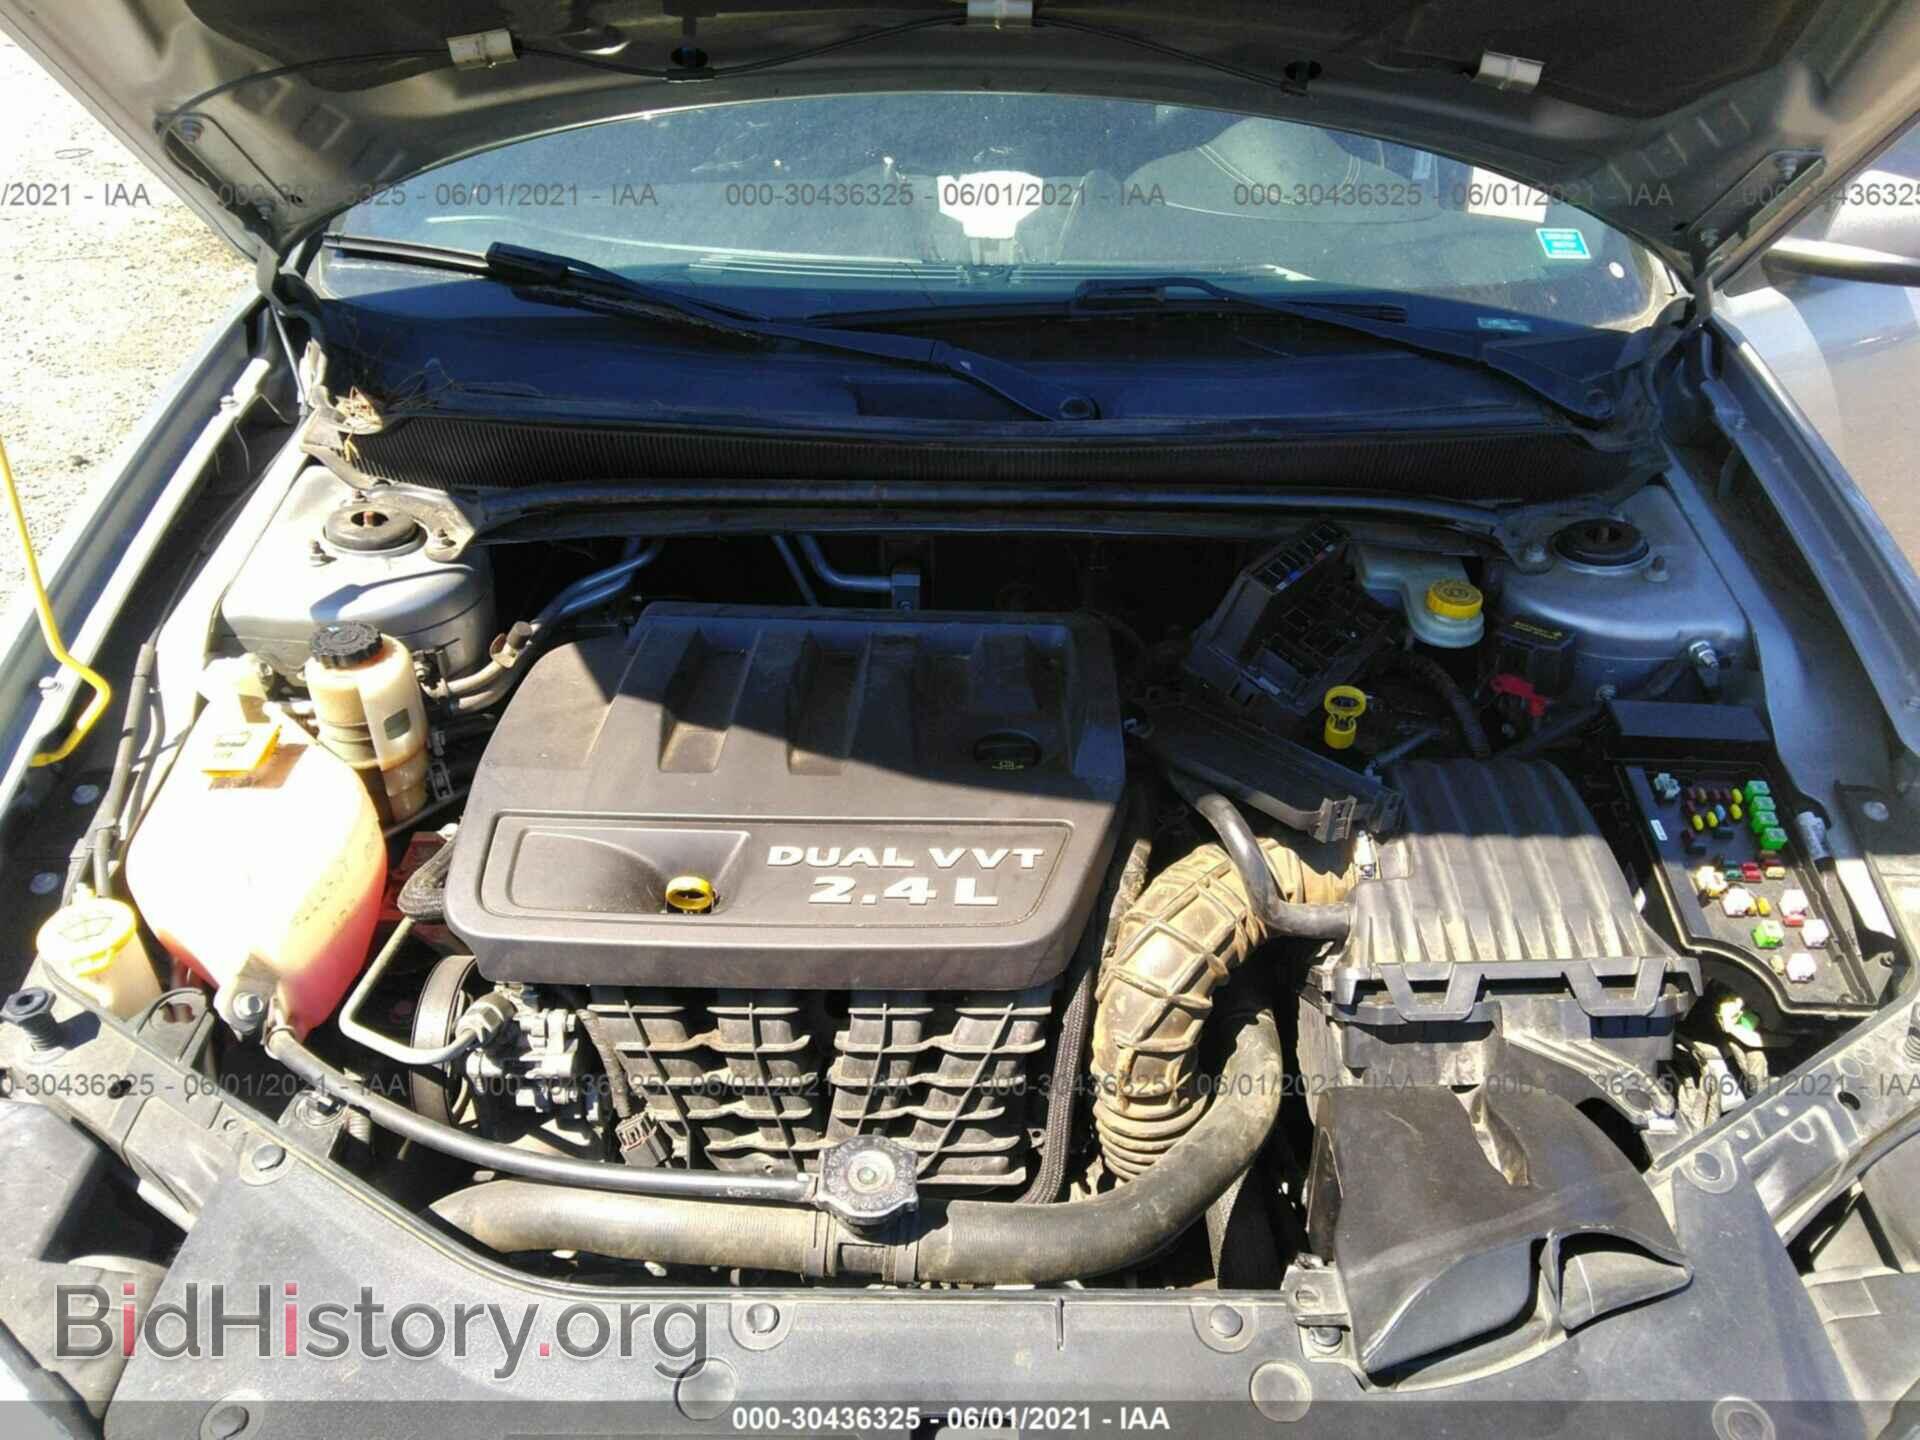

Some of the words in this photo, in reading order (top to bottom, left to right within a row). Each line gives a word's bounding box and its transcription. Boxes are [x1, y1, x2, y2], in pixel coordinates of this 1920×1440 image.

[767, 846, 915, 868] DUAL
[928, 848, 1044, 868] VVT
[808, 876, 938, 905] 2.4
